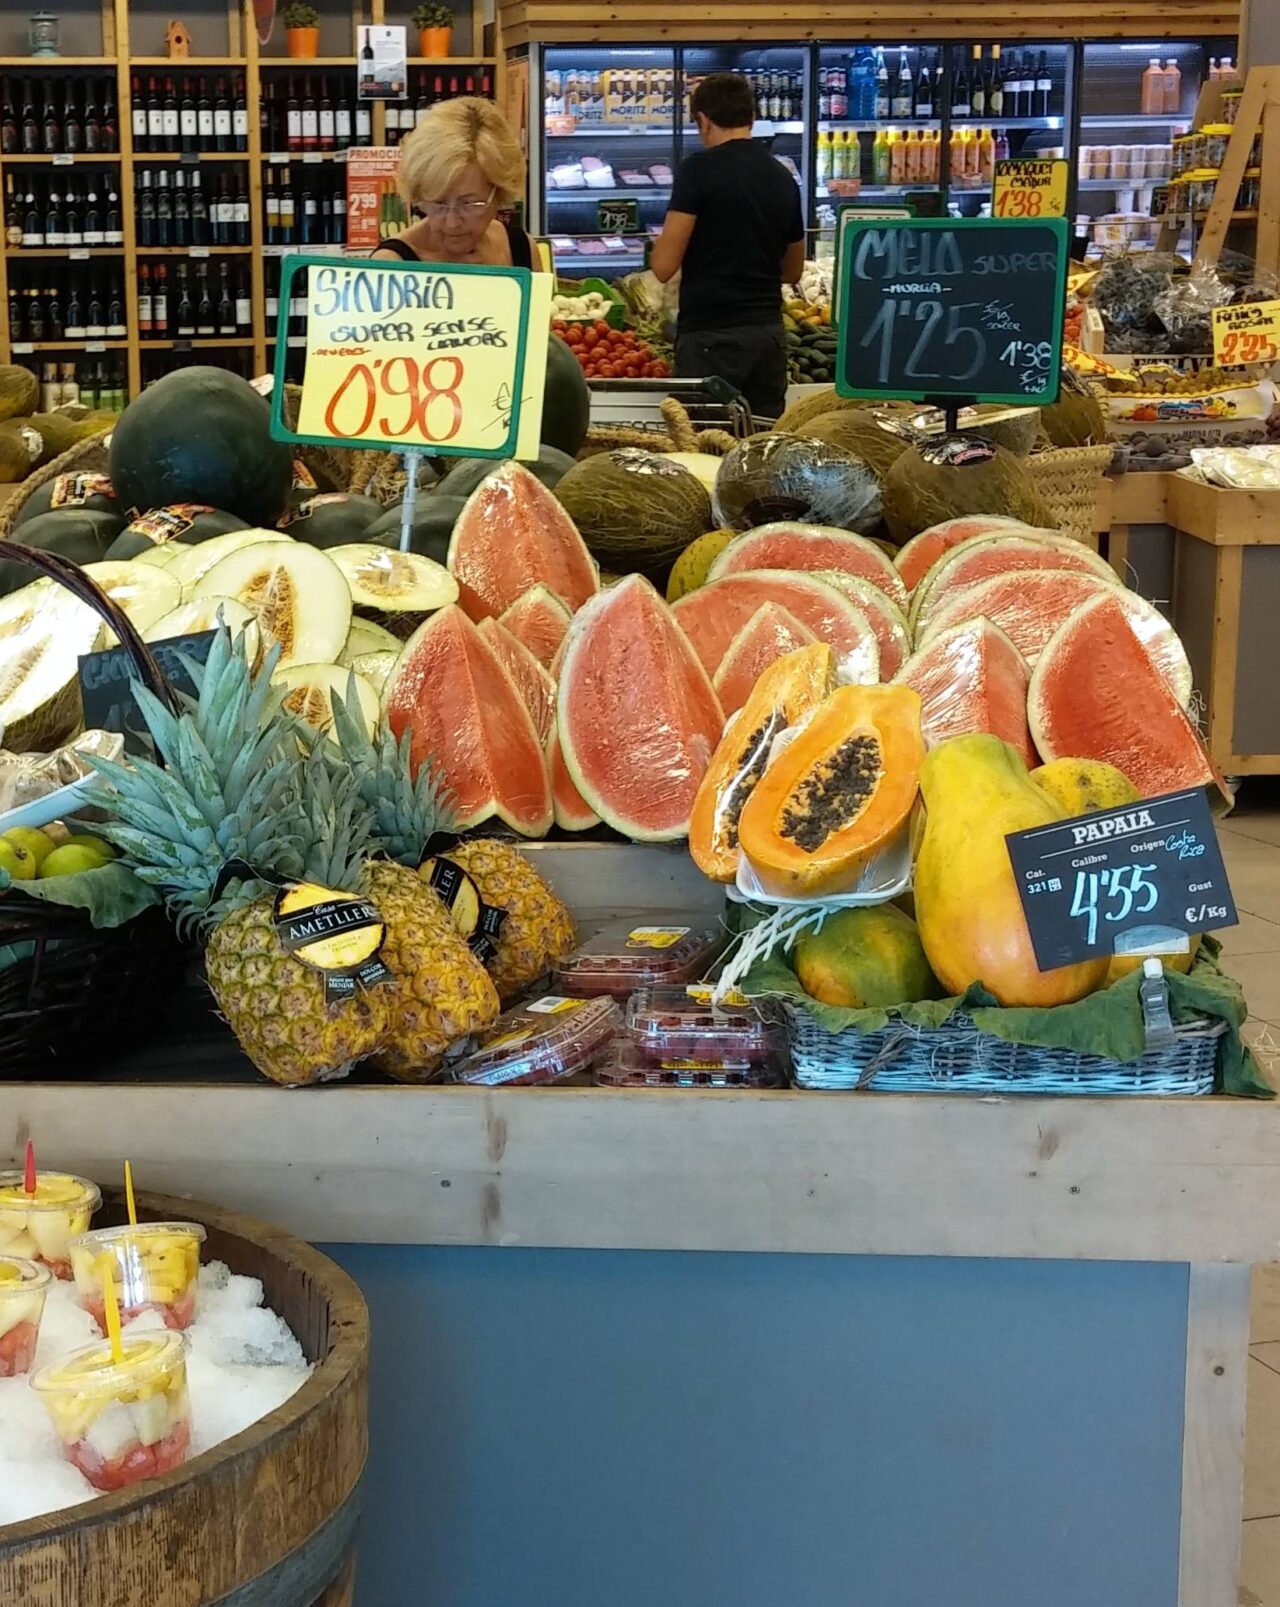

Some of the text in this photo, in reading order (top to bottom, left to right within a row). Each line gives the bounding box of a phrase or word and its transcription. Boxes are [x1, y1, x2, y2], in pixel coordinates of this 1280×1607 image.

[610, 105, 646, 115] MORITZ
[971, 251, 1057, 274] SUPER
[331, 316, 498, 343] SUPER SENSE
[860, 299, 987, 383] 1'25
[324, 356, 464, 442] 0'98
[1071, 810, 1155, 845] PAPAIA
[1130, 838, 1165, 853] Origen
[1071, 853, 1108, 868] Calibre
[1025, 869, 1046, 880] Cat.
[1028, 881, 1046, 894] 321
[1188, 880, 1213, 893] Gust
[312, 904, 336, 916] Casa
[1070, 864, 1159, 945] 4'55
[1185, 904, 1227, 923] €/Kg
[289, 906, 376, 941] AMETLLER
